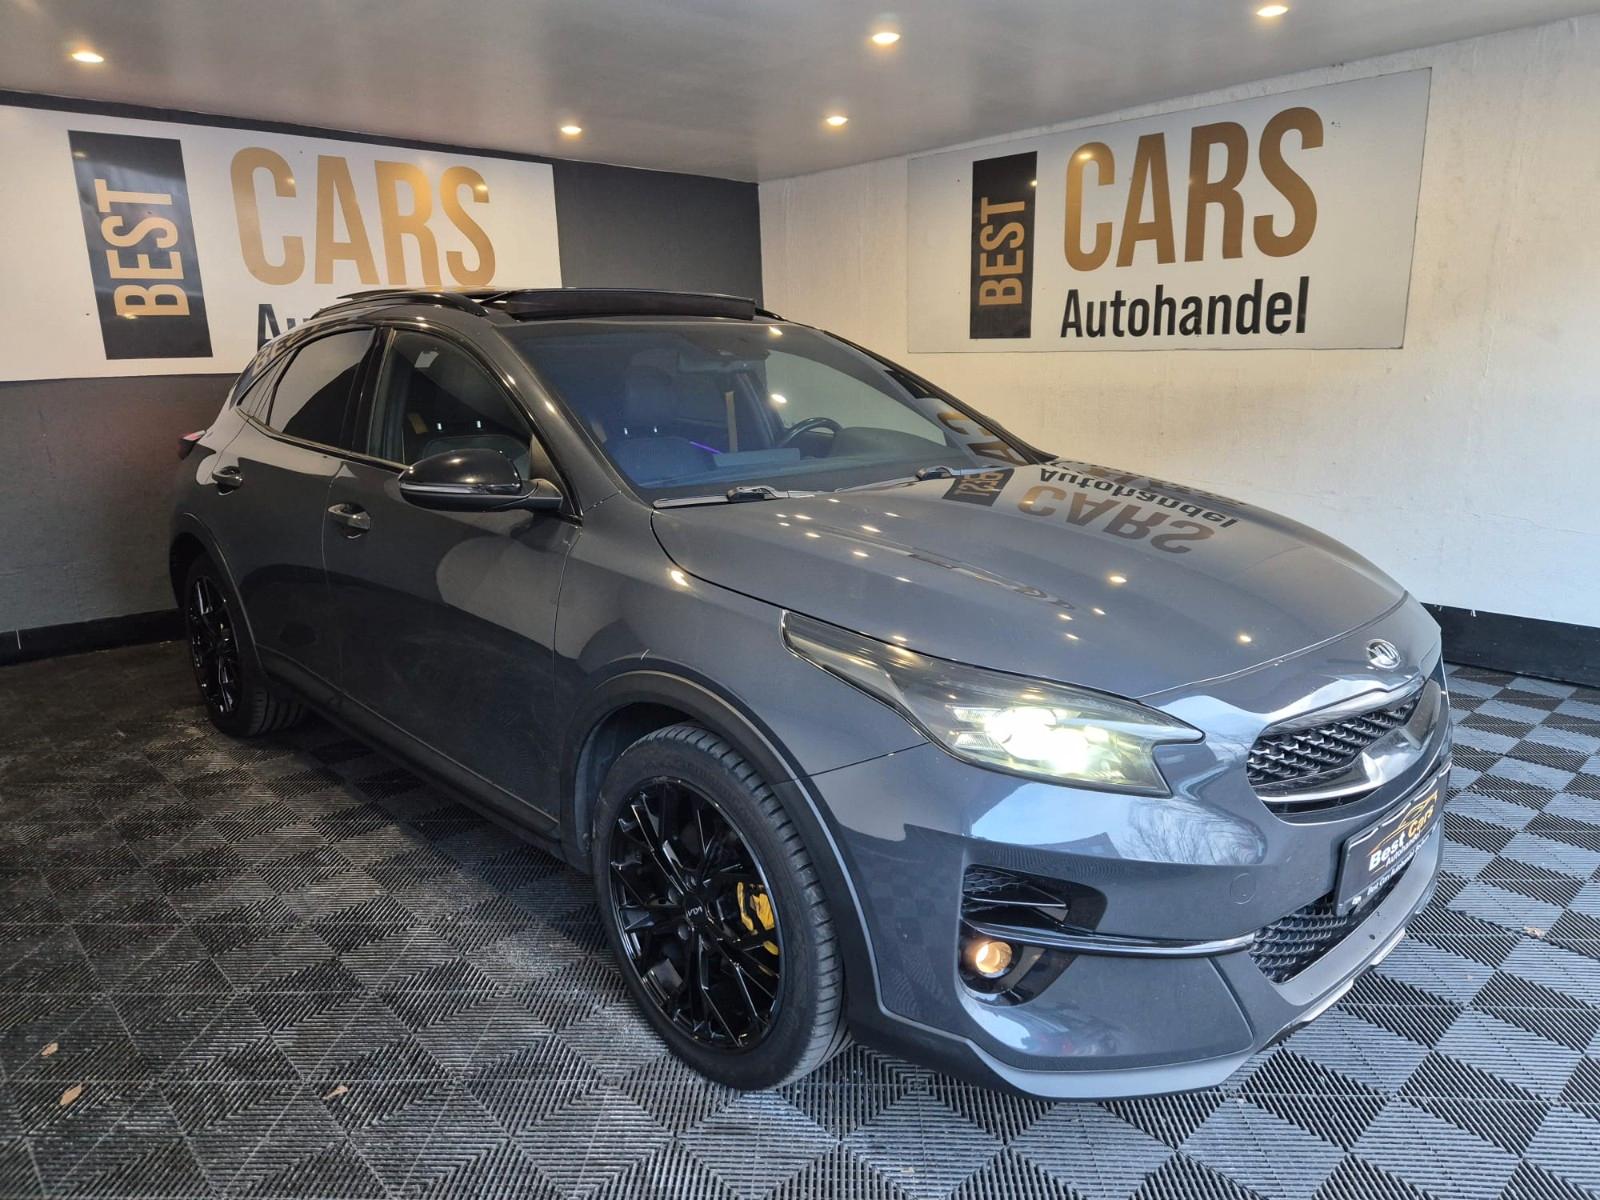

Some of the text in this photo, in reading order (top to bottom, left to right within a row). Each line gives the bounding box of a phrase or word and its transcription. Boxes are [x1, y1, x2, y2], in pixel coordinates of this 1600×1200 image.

[95, 178, 191, 317] BEST
[230, 146, 496, 287] CARS
[979, 196, 1026, 307] BEST
[1063, 106, 1324, 272] CARS
[1060, 276, 1310, 338] Autohandel
[1368, 831, 1406, 871] Best
